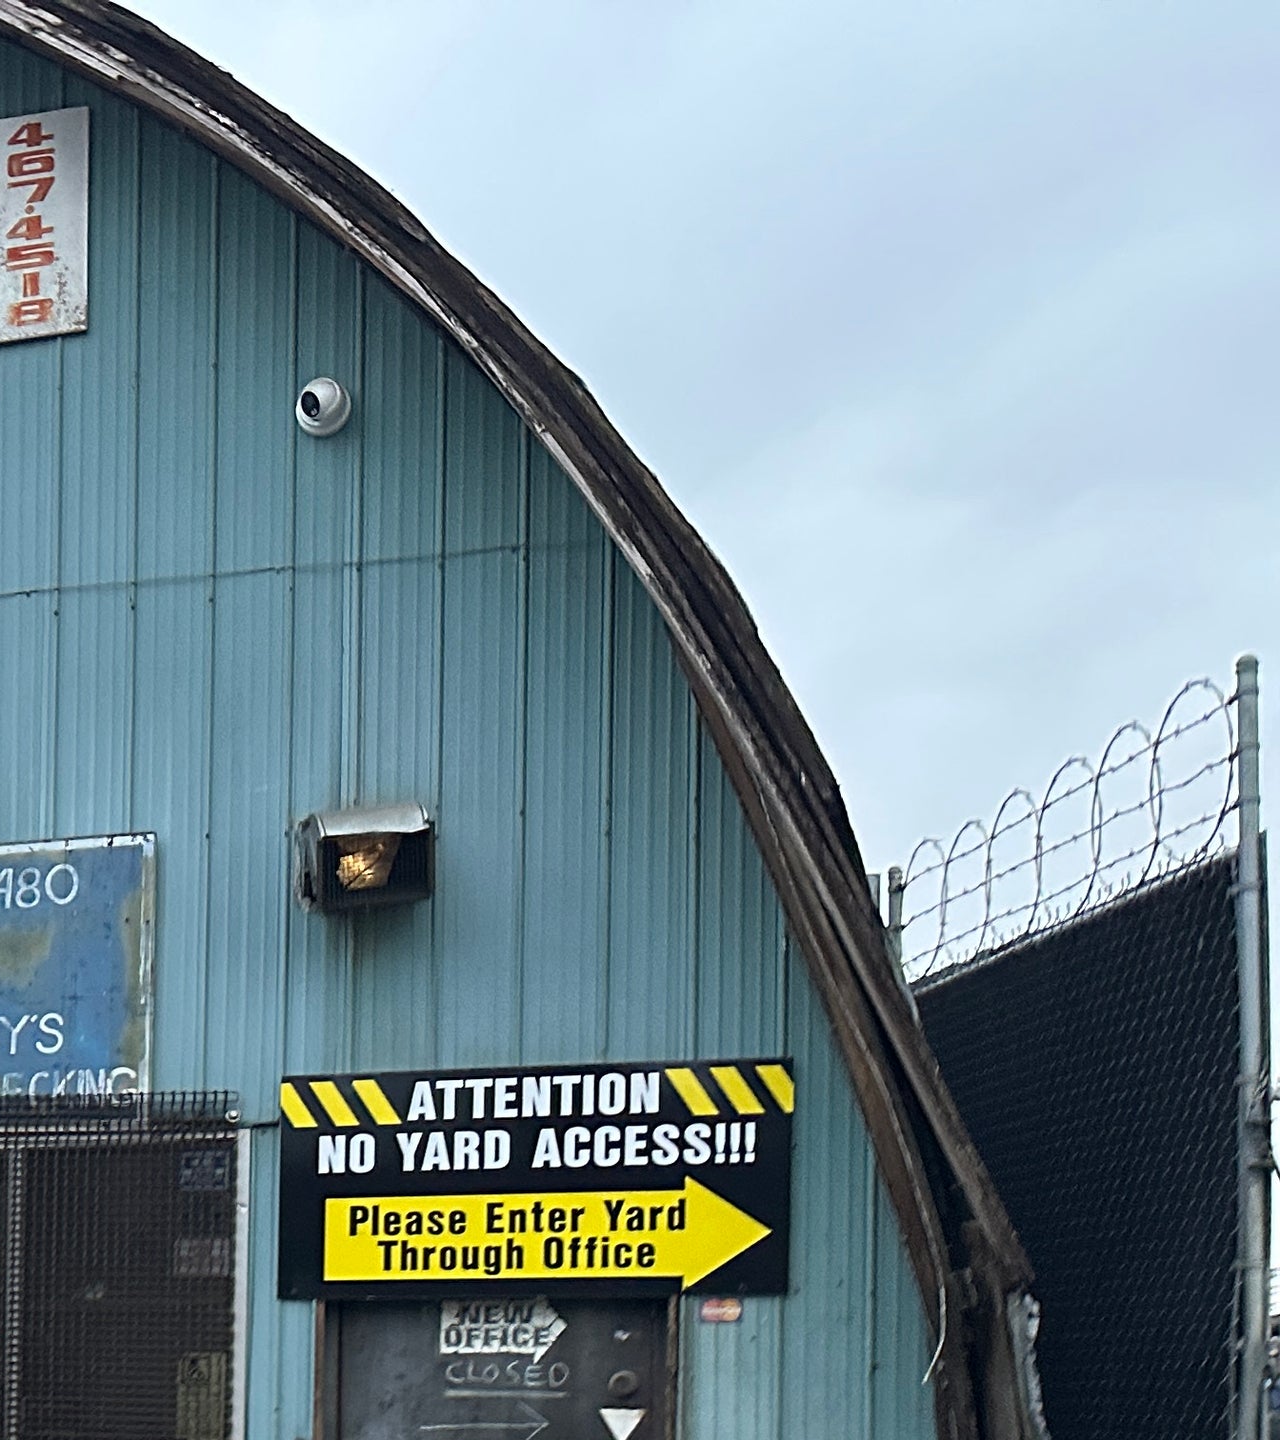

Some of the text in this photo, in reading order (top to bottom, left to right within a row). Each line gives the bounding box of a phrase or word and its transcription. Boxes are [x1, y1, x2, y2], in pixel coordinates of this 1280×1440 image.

[406, 1071, 661, 1123] ATTENTION
[317, 1121, 757, 1175] NO YARD ACCESS!!!
[349, 1199, 687, 1237] Please Enter Yard
[377, 1236, 656, 1276] Through Office
[444, 1323, 553, 1349] OFFICE
[445, 1359, 570, 1388] CLOSED
